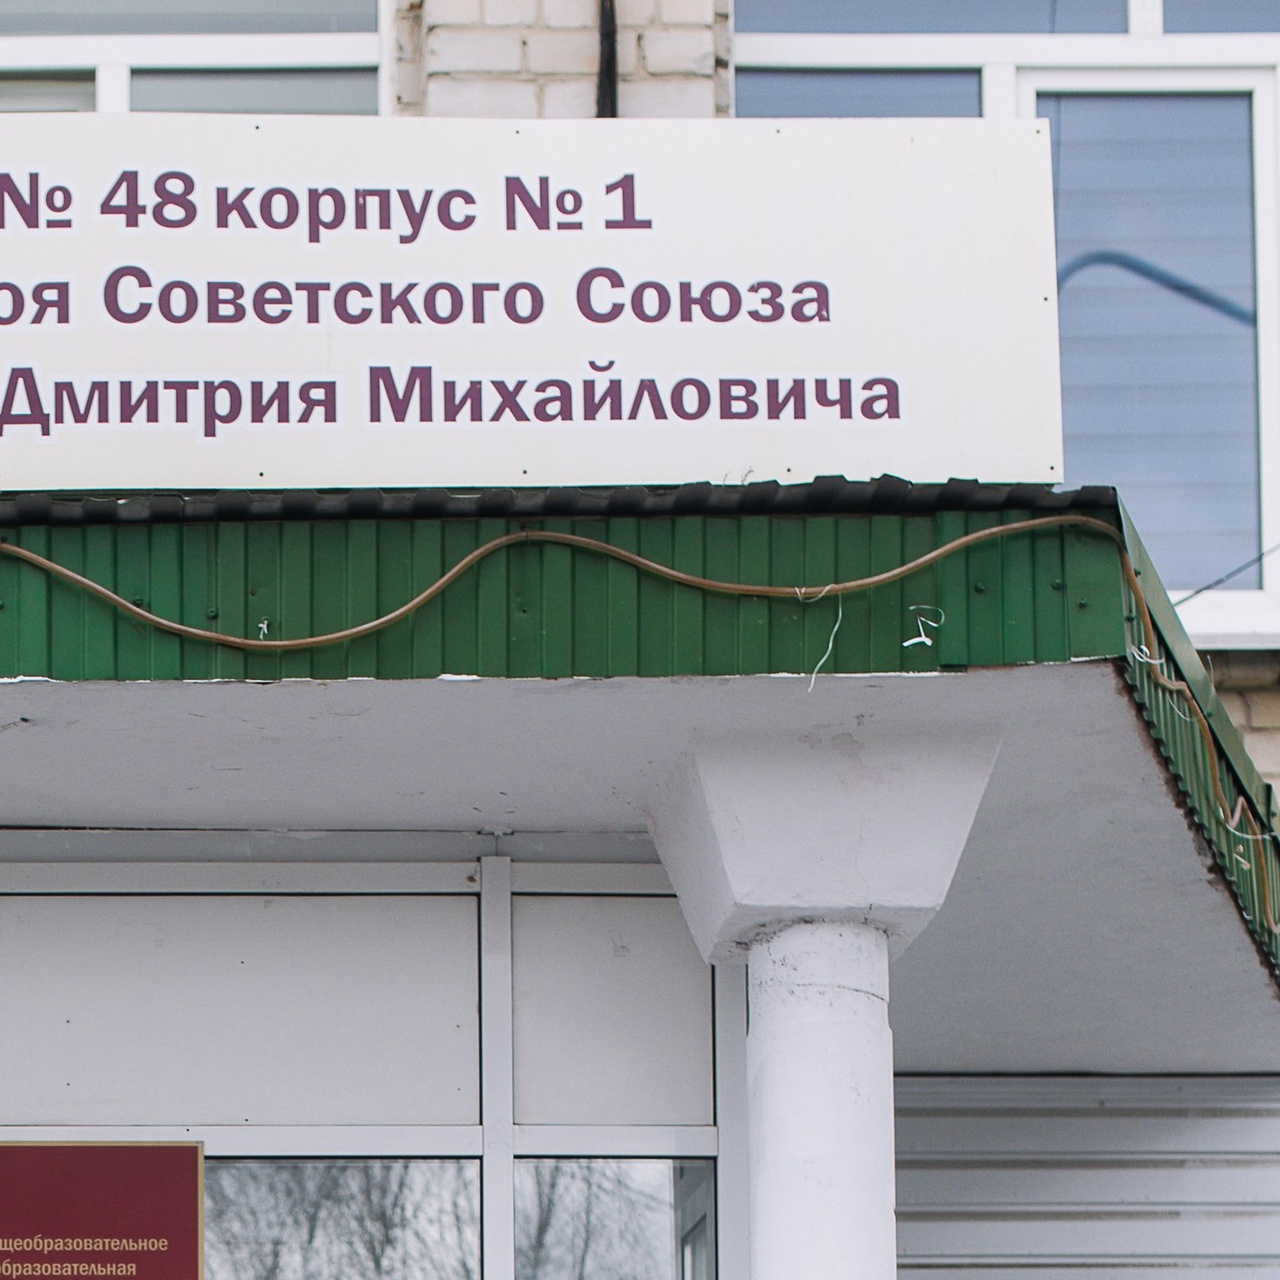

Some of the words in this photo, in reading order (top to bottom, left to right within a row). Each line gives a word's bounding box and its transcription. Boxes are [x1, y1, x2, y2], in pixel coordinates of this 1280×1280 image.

[99, 171, 198, 230] 48
[215, 188, 475, 246] корпус
[504, 177, 583, 232] №
[603, 175, 653, 231] 1
[104, 266, 544, 326] Советского
[575, 268, 830, 325] Союза
[369, 361, 900, 424] Михайловича
